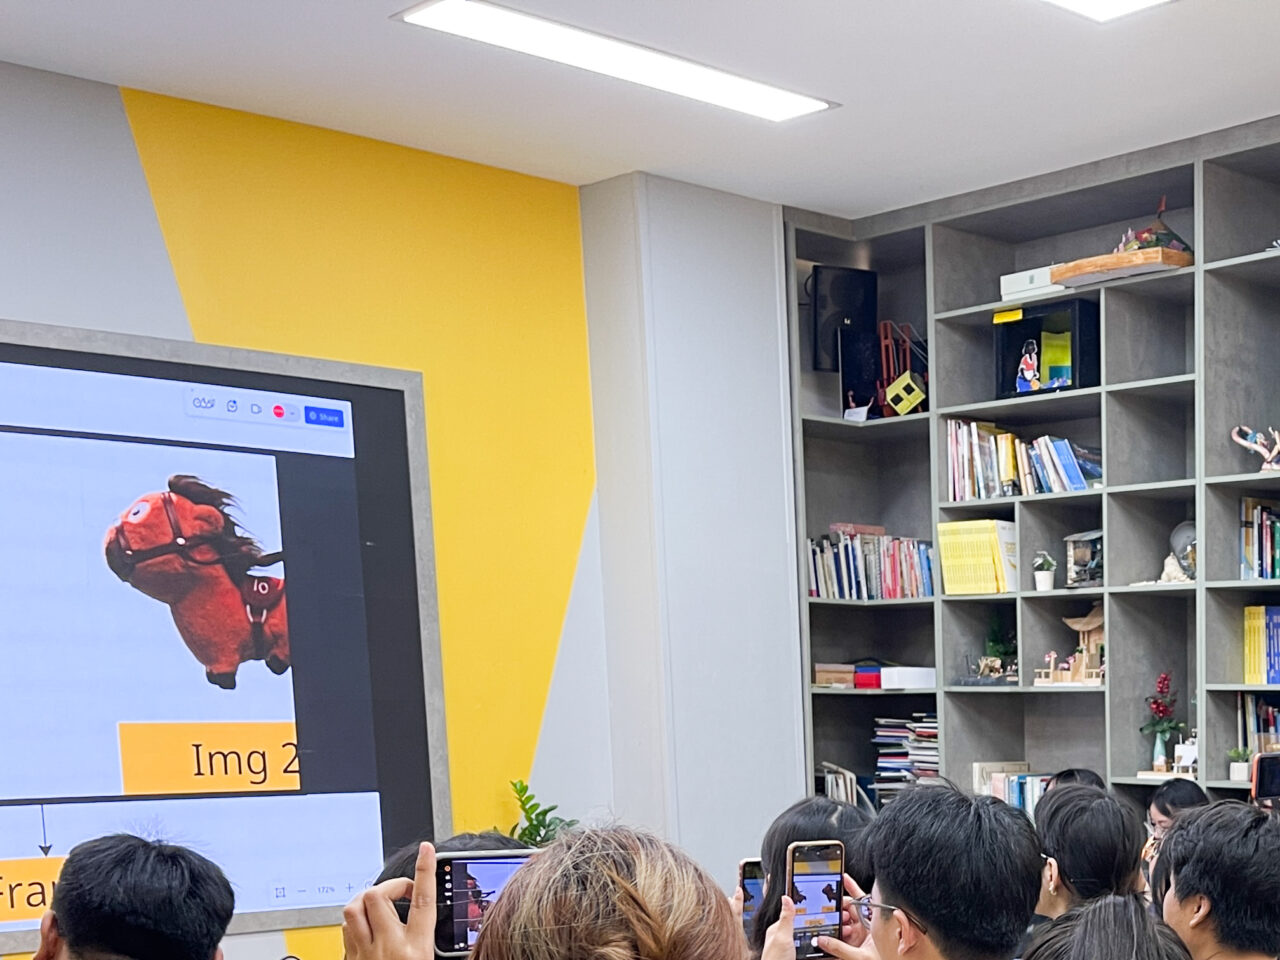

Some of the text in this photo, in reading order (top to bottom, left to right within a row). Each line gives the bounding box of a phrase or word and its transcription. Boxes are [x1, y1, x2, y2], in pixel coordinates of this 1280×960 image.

[318, 412, 340, 422] Share
[192, 743, 300, 784] Img 2
